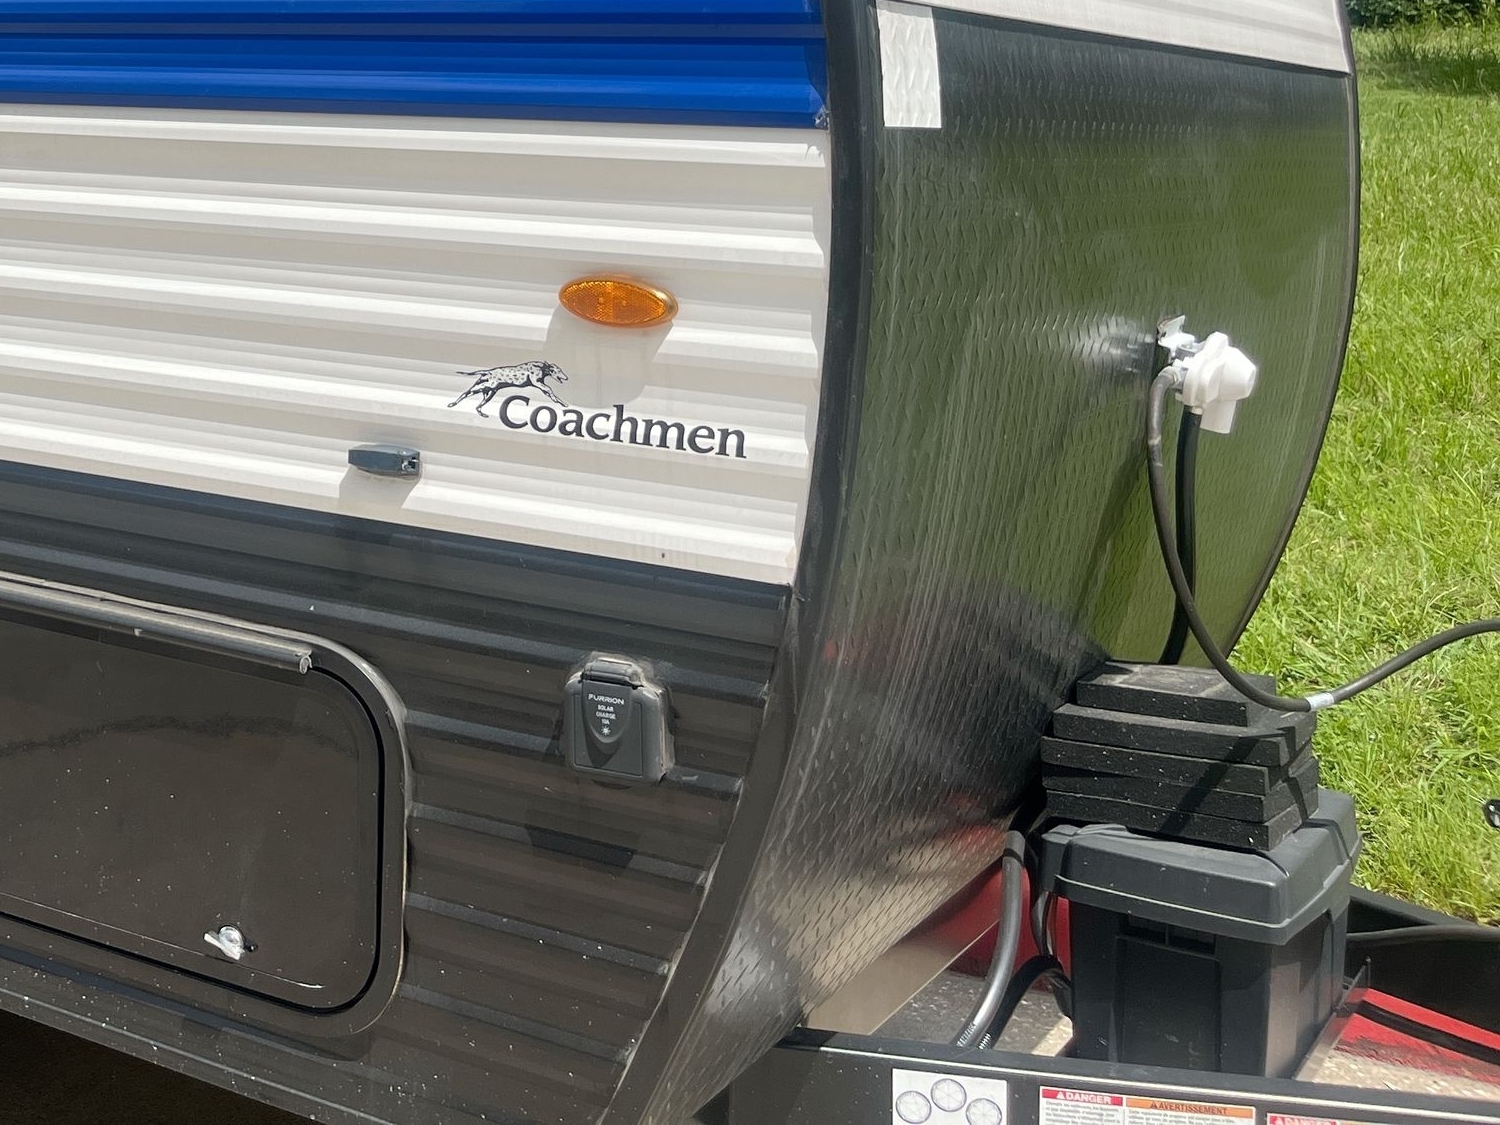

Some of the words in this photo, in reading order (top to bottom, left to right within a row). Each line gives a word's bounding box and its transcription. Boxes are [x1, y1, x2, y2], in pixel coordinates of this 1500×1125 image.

[499, 395, 747, 458] Coachmen
[588, 693, 625, 705] FURRION
[1066, 1091, 1112, 1105] DANGER
[1158, 1101, 1227, 1115] AVERTISSEMENT
